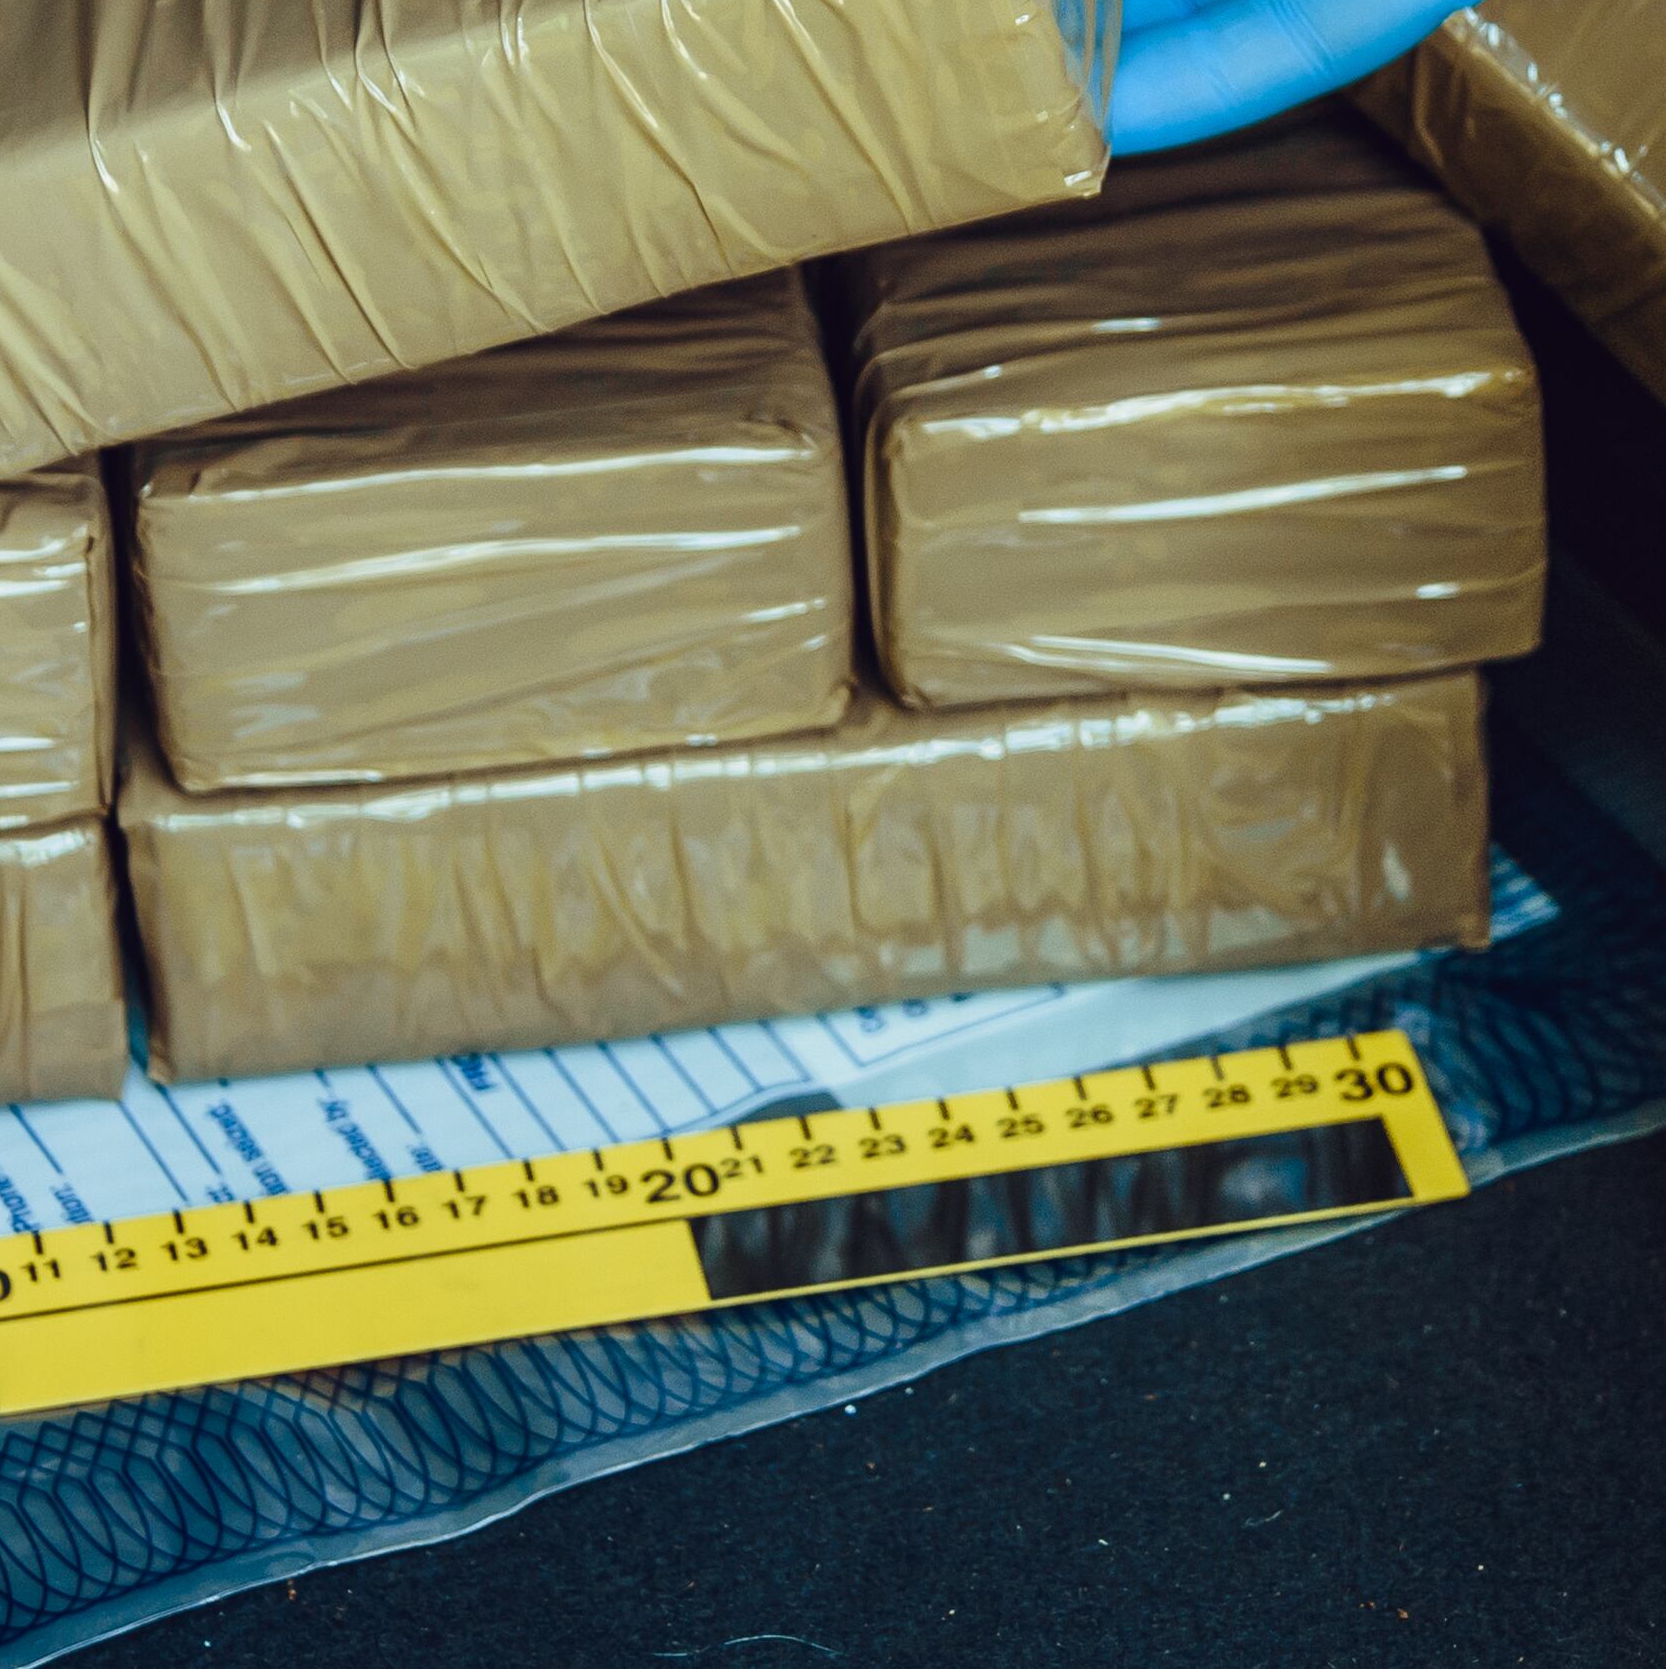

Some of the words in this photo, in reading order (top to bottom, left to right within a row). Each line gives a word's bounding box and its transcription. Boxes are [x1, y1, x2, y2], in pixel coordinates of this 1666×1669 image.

[23, 1258, 61, 1283] 11
[93, 1248, 137, 1272] 12
[164, 1237, 209, 1262] 13
[235, 1227, 278, 1251] 14
[304, 1216, 350, 1241] 15
[375, 1206, 420, 1230] 16
[444, 1195, 487, 1220] 17
[514, 1185, 560, 1209] 18
[585, 1175, 630, 1198] 19
[641, 1163, 721, 1205] 20
[717, 1155, 764, 1182] 21
[789, 1145, 837, 1170] 22
[859, 1134, 907, 1160] 23
[928, 1124, 976, 1150] 24
[997, 1114, 1046, 1140] 25
[1066, 1104, 1114, 1129] 26
[1134, 1093, 1178, 1120] 27
[1203, 1084, 1252, 1110] 28
[1271, 1073, 1320, 1100] 29
[1335, 1063, 1415, 1102] 30
